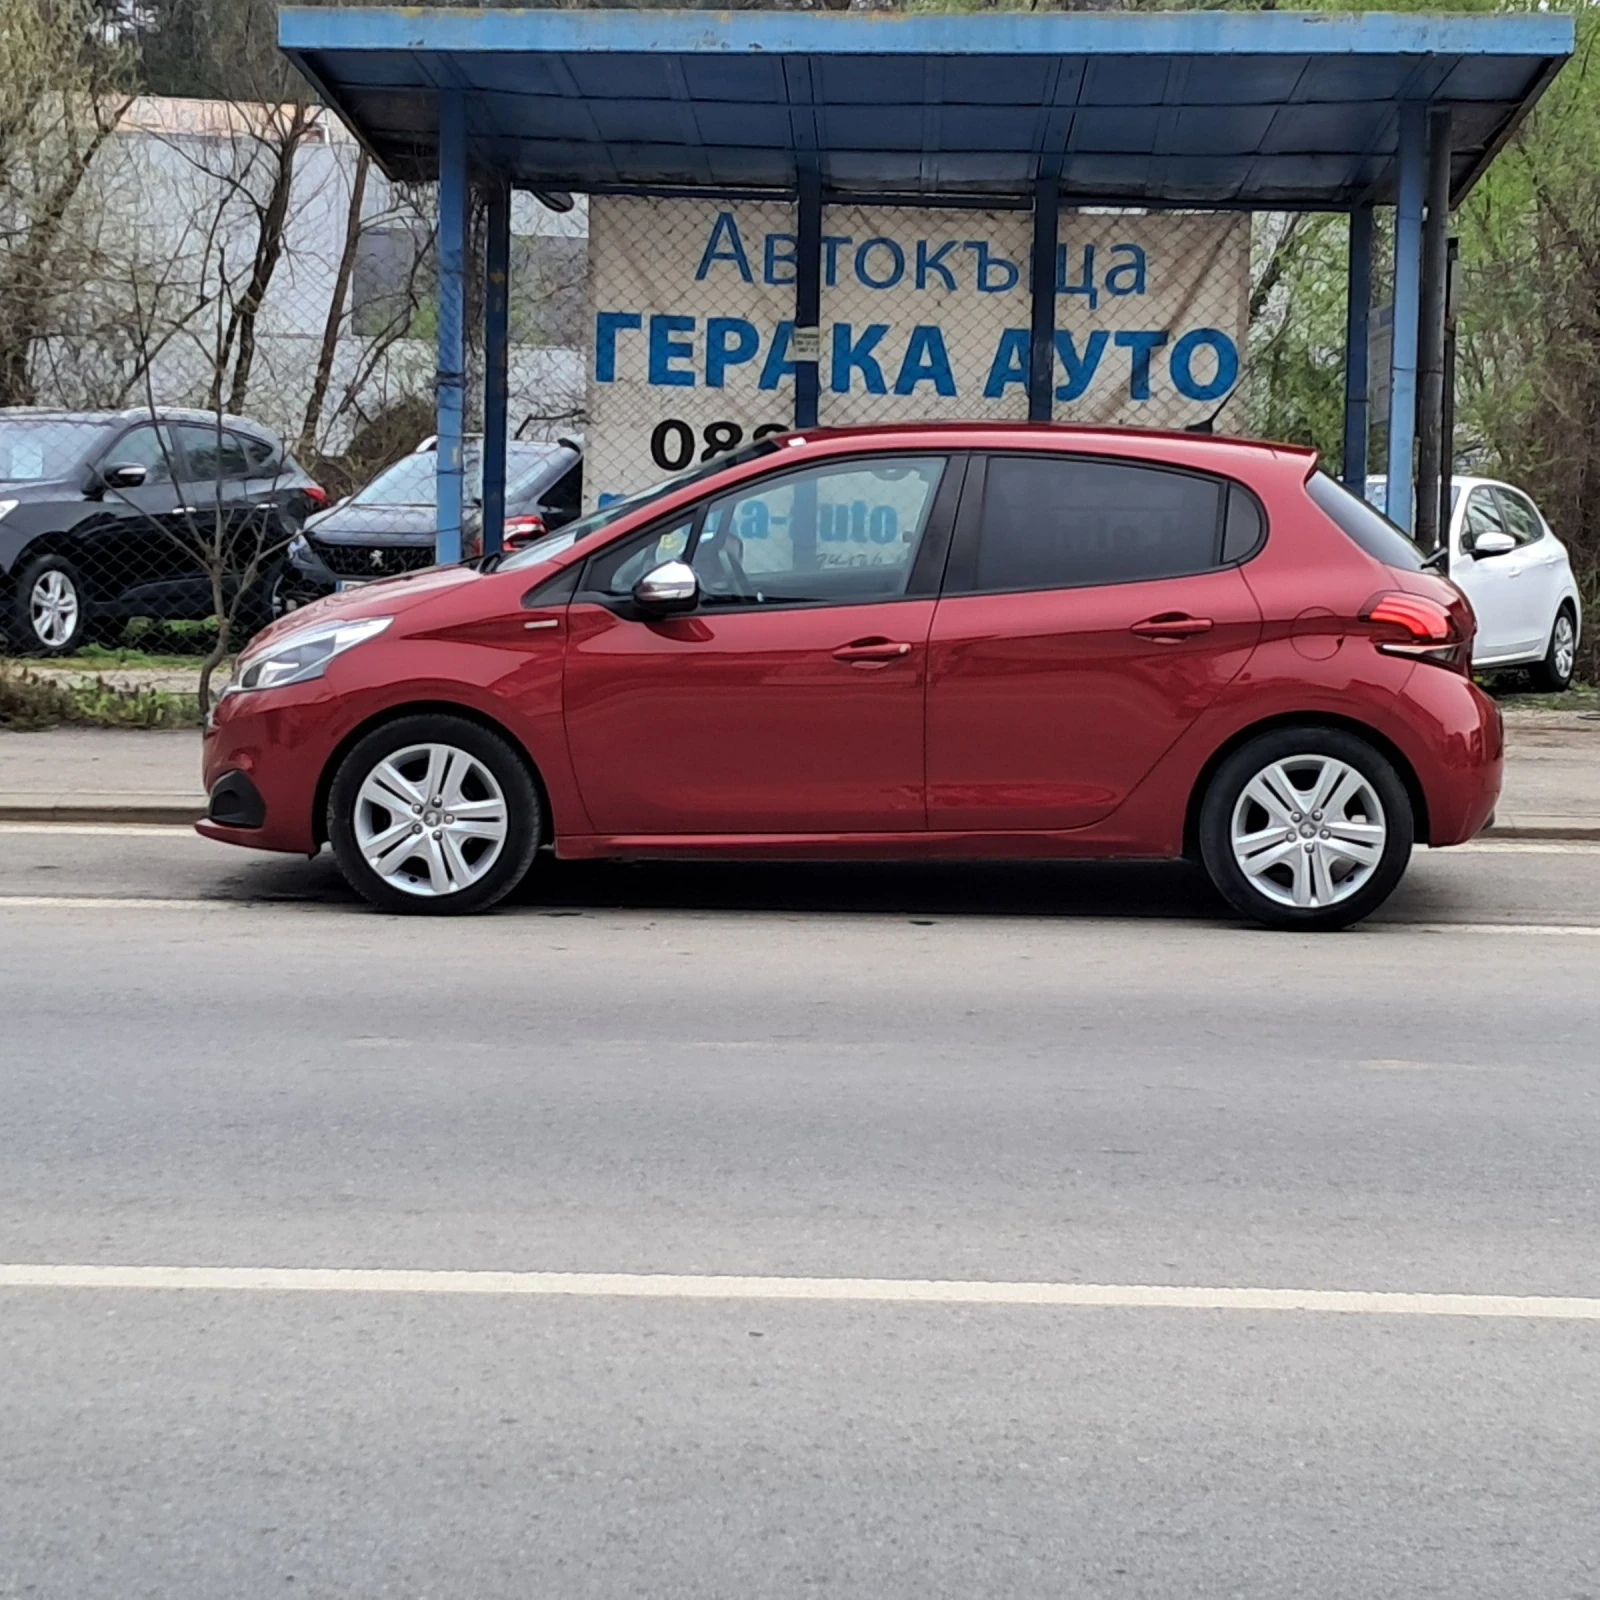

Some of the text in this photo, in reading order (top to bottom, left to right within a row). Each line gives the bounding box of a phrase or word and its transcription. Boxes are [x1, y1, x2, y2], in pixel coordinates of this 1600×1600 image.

[694, 211, 1146, 310] Автокъща
[983, 327, 1239, 402] АУТО
[650, 418, 791, 472] 08
